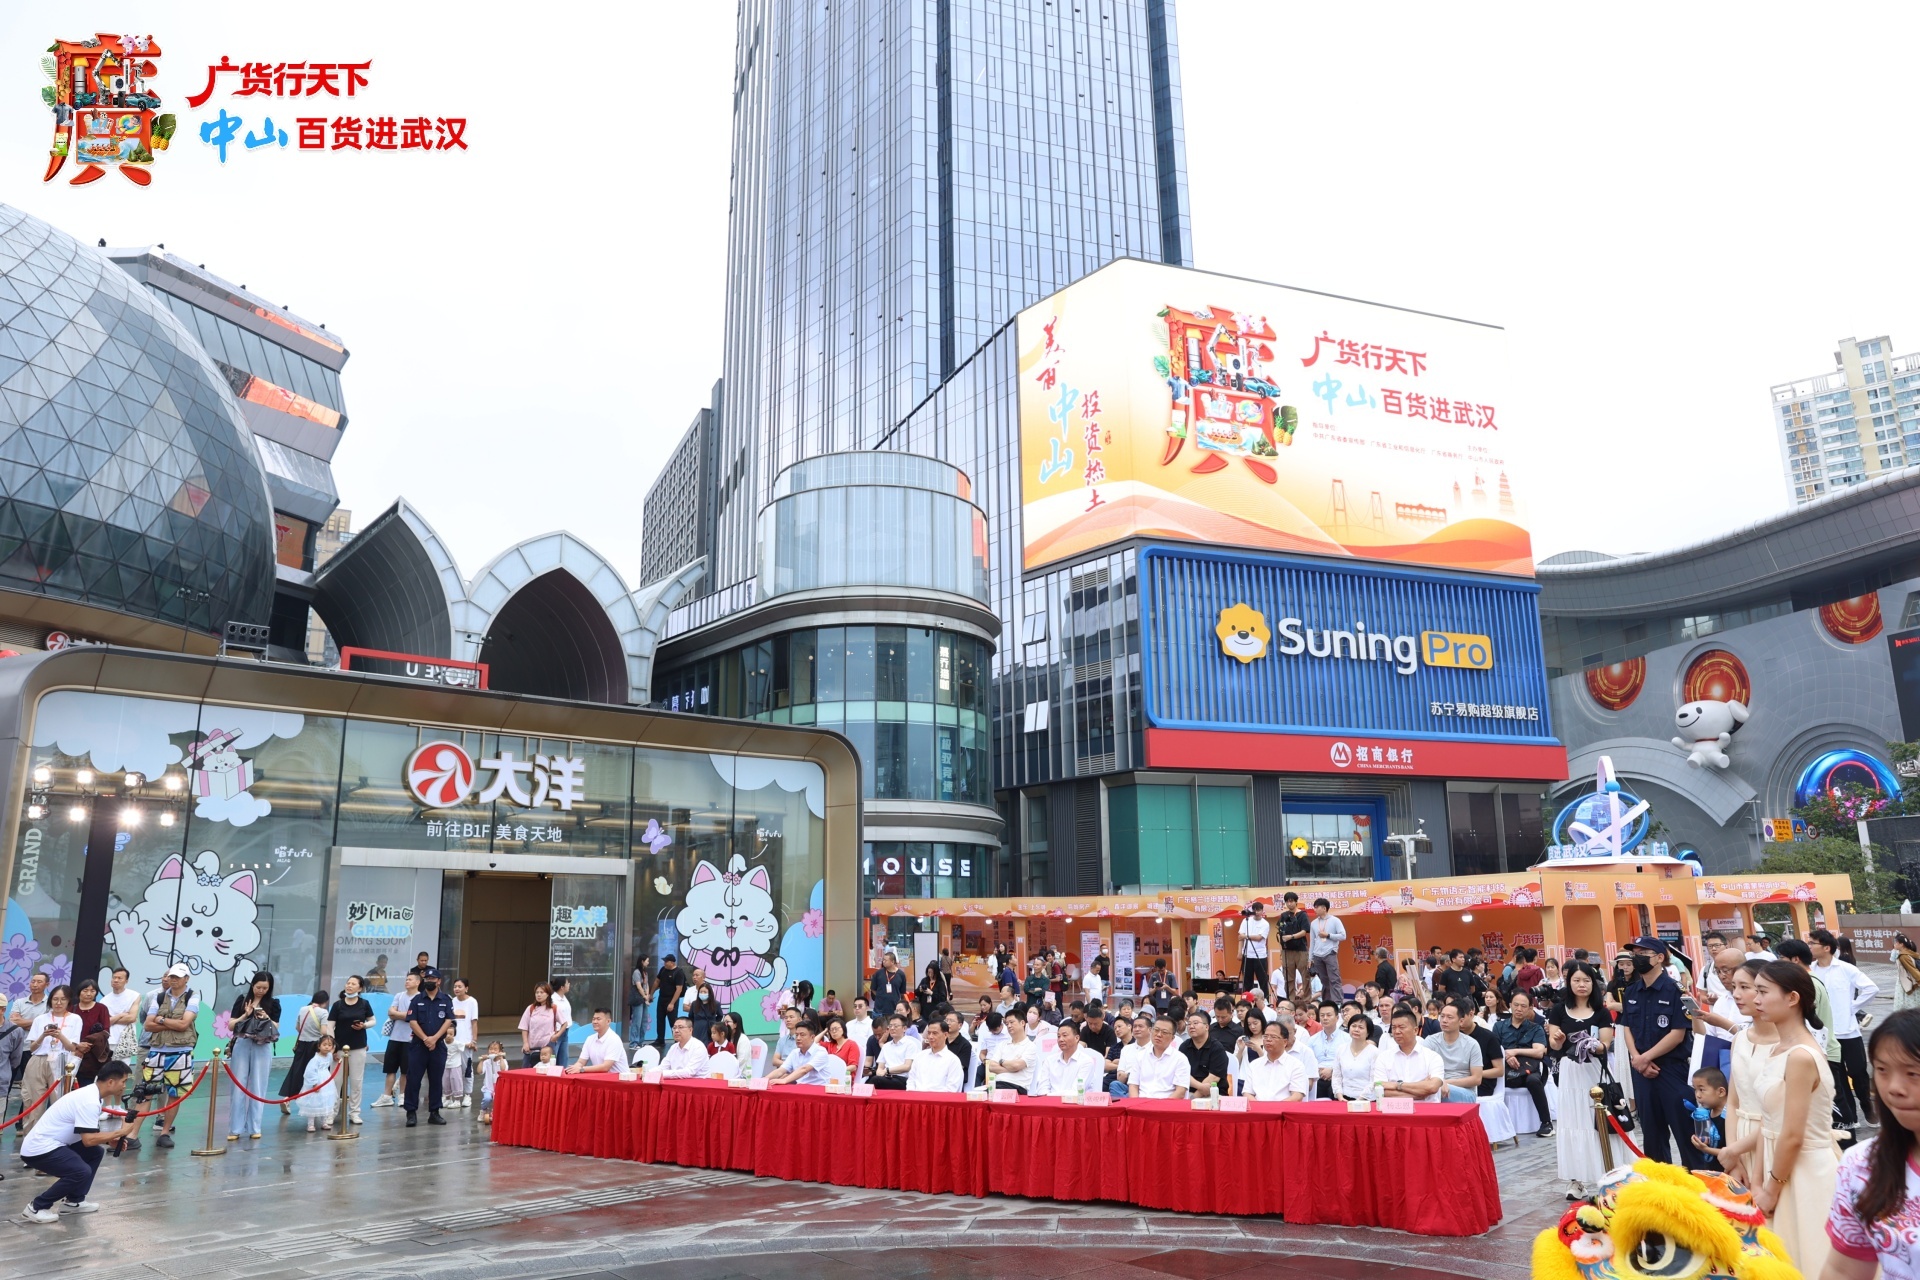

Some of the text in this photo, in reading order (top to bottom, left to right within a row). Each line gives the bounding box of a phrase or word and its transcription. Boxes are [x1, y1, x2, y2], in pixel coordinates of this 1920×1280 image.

[1300, 330, 1427, 377] 广货行天下
[1278, 617, 1488, 675] Suning Pro
[1430, 701, 1539, 721] 苏宁易购超级旗舰店
[1355, 745, 1414, 764] 招商银行
[479, 751, 585, 811] 大洋
[426, 820, 563, 843] 前往B1F 美食天地
[1311, 840, 1364, 856] 苏宁易购
[17, 828, 43, 896] GRAND
[551, 905, 607, 925] 趣大洋
[336, 936, 373, 946] OMING
[352, 924, 410, 938] GRAND
[1854, 939, 1884, 949] 美食街
